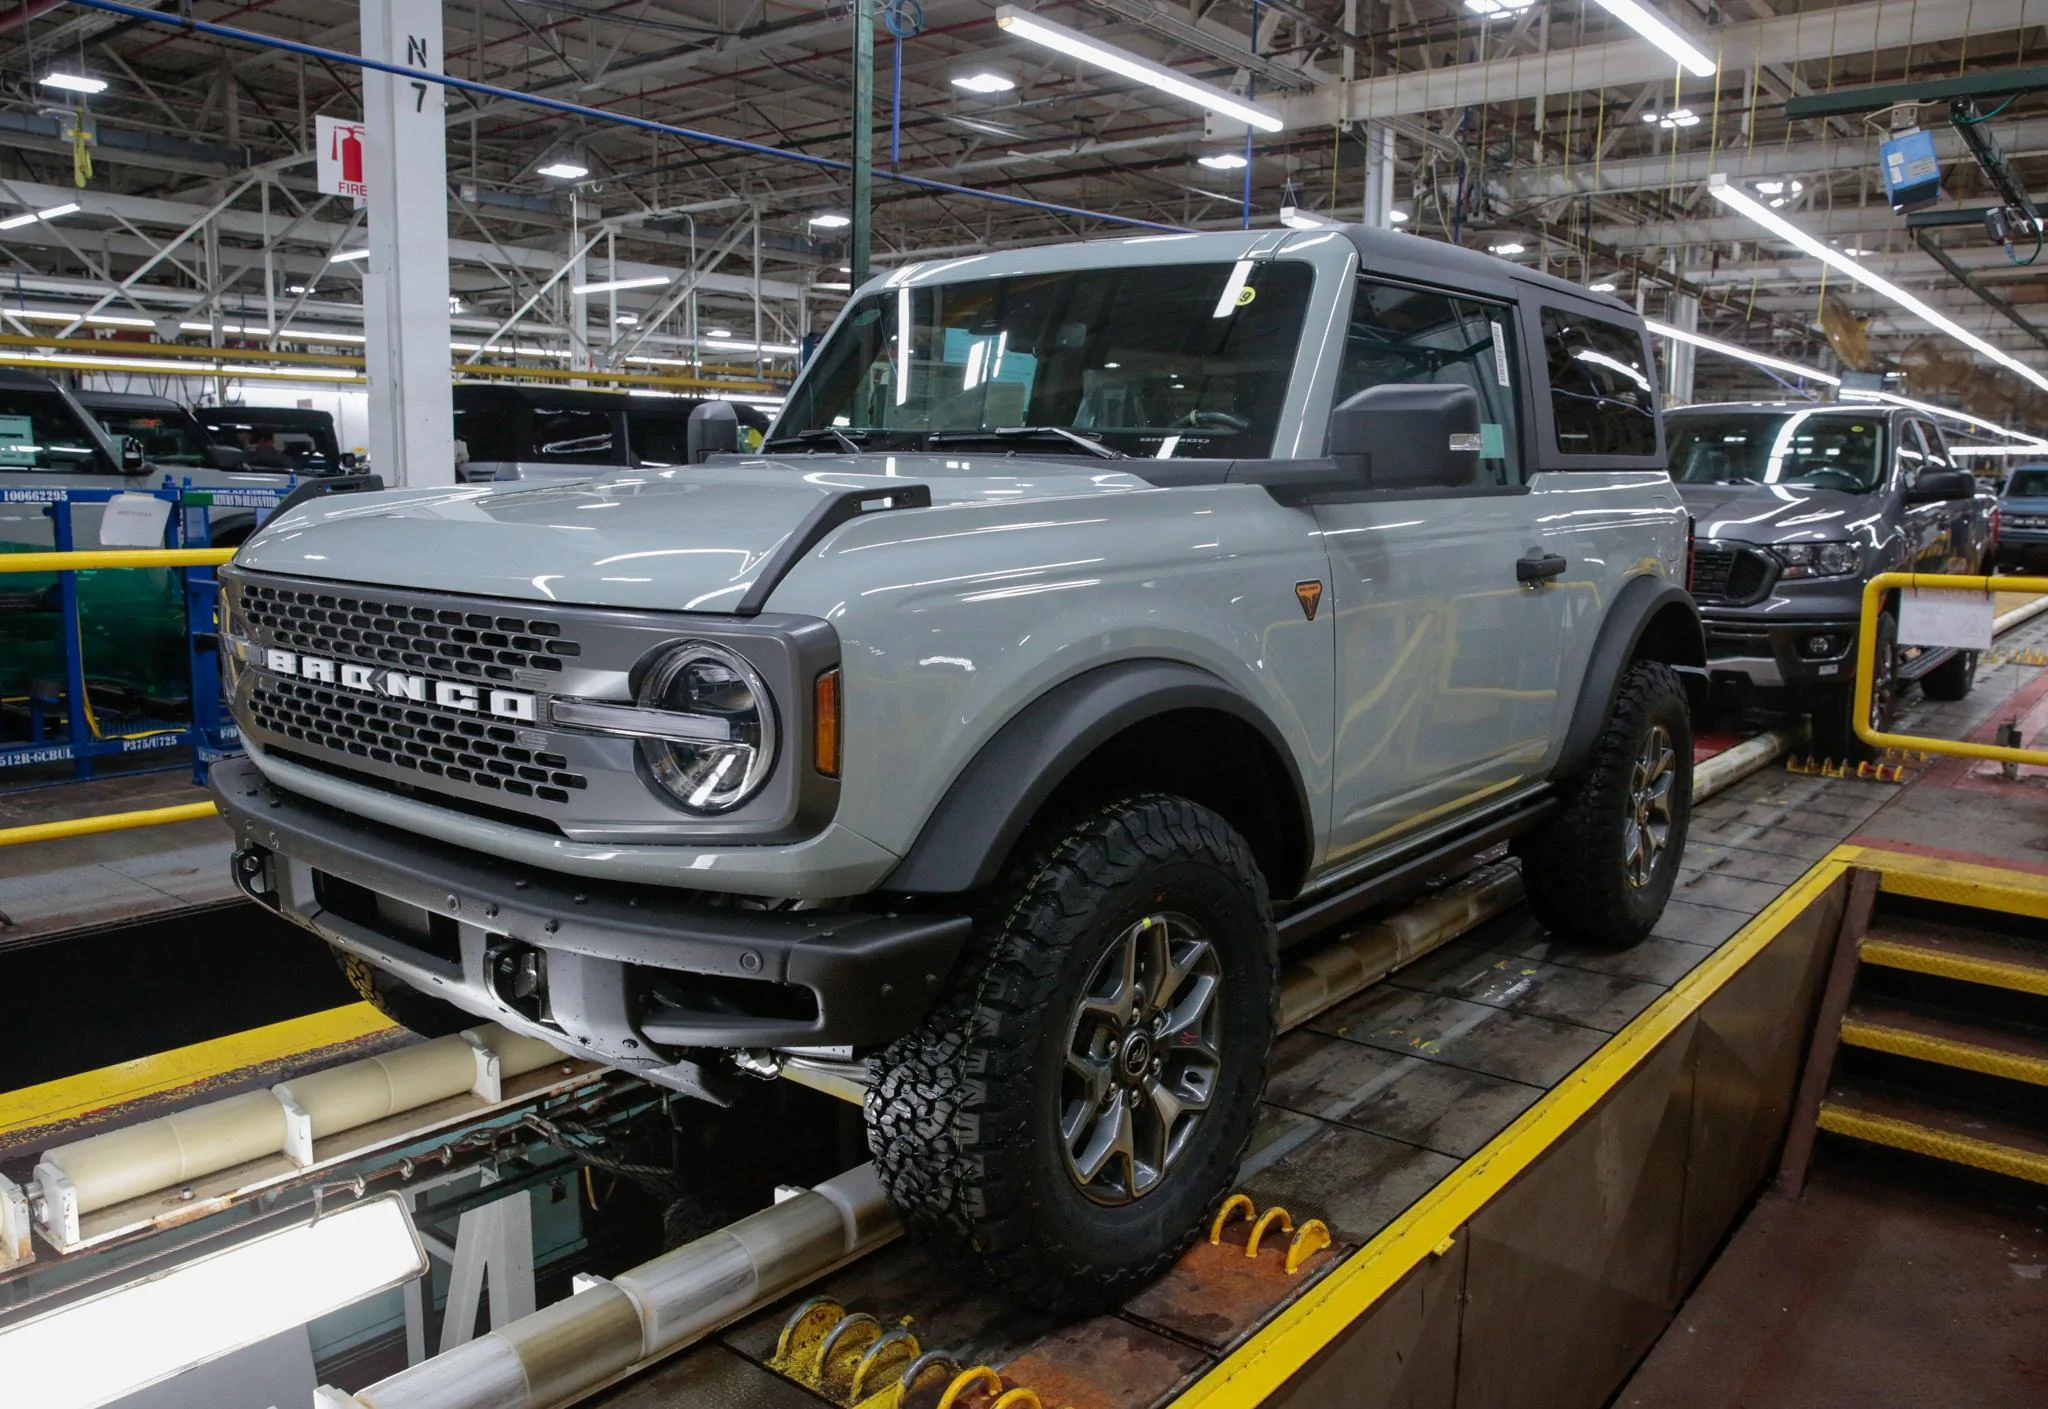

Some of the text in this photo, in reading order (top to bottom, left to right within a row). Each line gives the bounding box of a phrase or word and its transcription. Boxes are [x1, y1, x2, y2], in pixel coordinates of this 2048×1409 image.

[408, 34, 427, 68] N
[410, 82, 427, 113] 7
[338, 181, 368, 197] FIRE
[4, 489, 68, 502] 100662295
[267, 648, 537, 722] BRONCO
[123, 736, 177, 751] P375/U725
